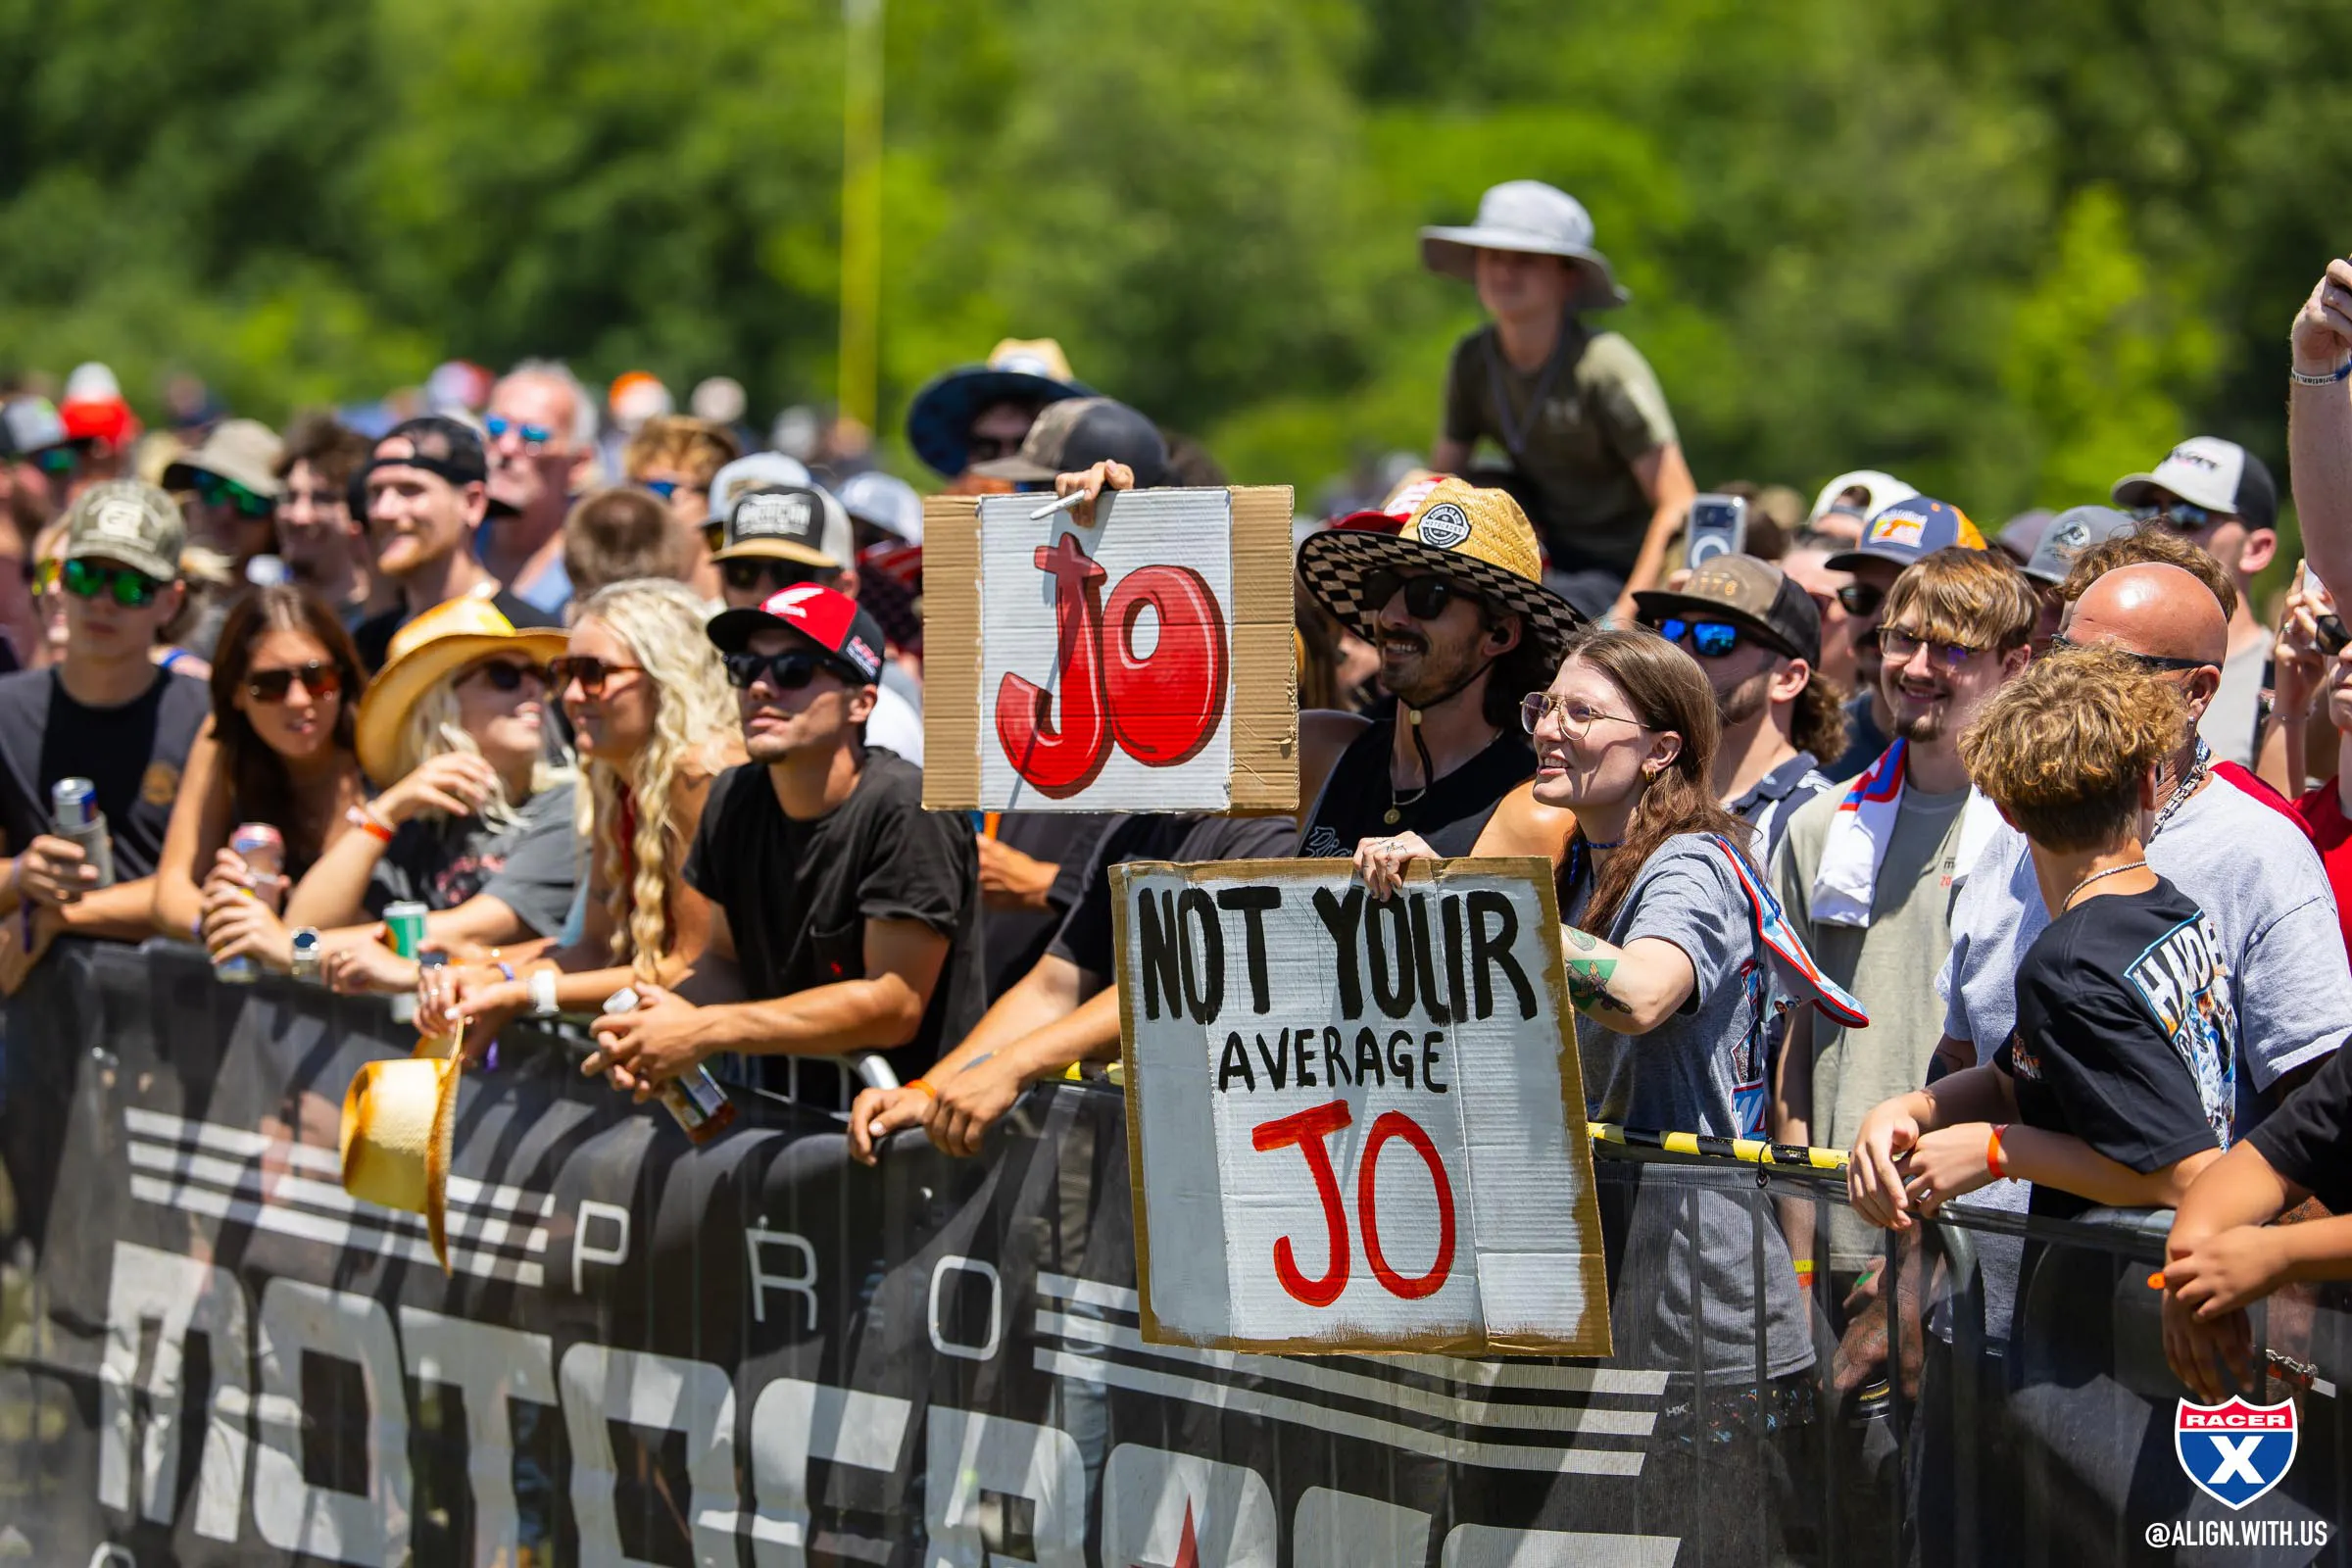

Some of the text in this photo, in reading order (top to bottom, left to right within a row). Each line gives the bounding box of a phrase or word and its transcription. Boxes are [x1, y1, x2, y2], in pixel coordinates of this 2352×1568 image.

[1138, 885, 1538, 1028] NOT YOUR
[1217, 1025, 1448, 1094] AVERAGE
[1251, 1099, 1456, 1308] JO
[96, 1239, 1682, 1568] MOTOCR
